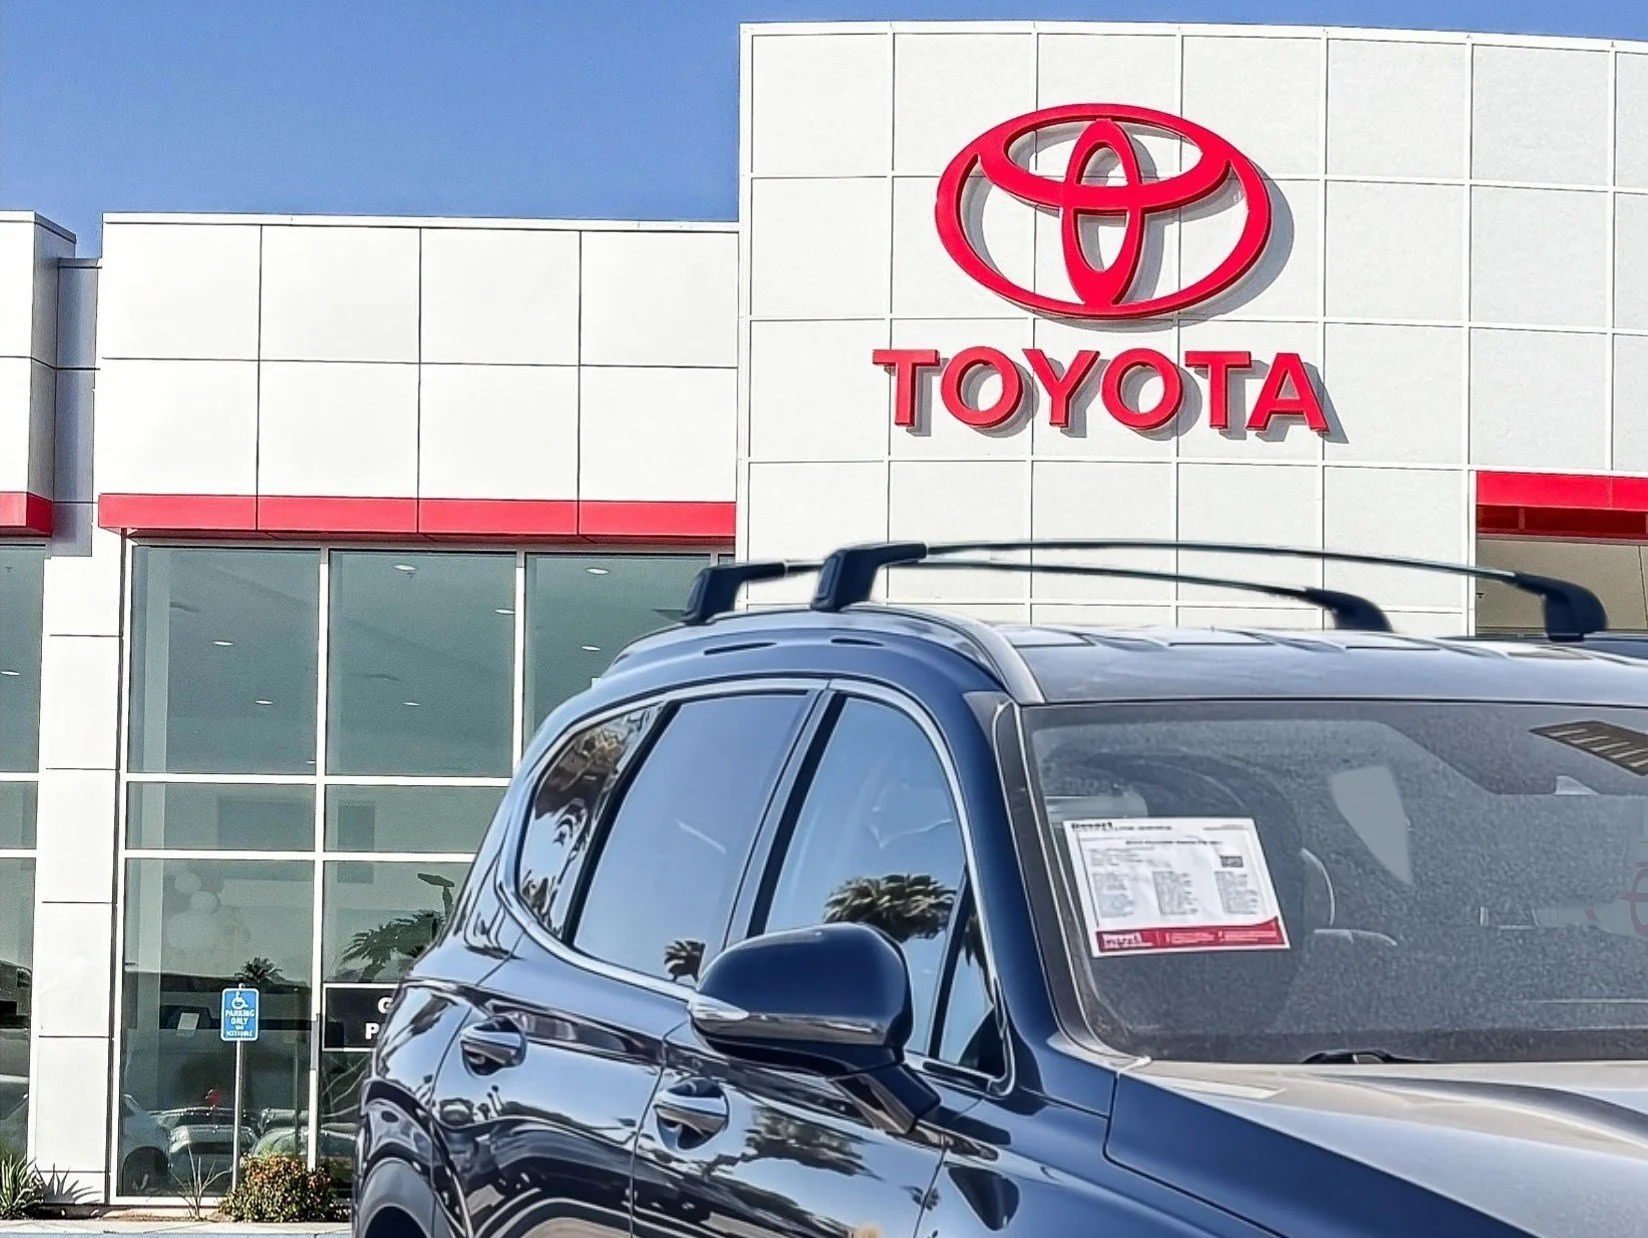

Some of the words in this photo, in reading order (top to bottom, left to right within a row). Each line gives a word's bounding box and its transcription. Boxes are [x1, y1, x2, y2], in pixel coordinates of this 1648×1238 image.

[872, 346, 1331, 432] TOYOTA
[225, 1009, 255, 1018] PARKING
[230, 1016, 249, 1025] ONLY
